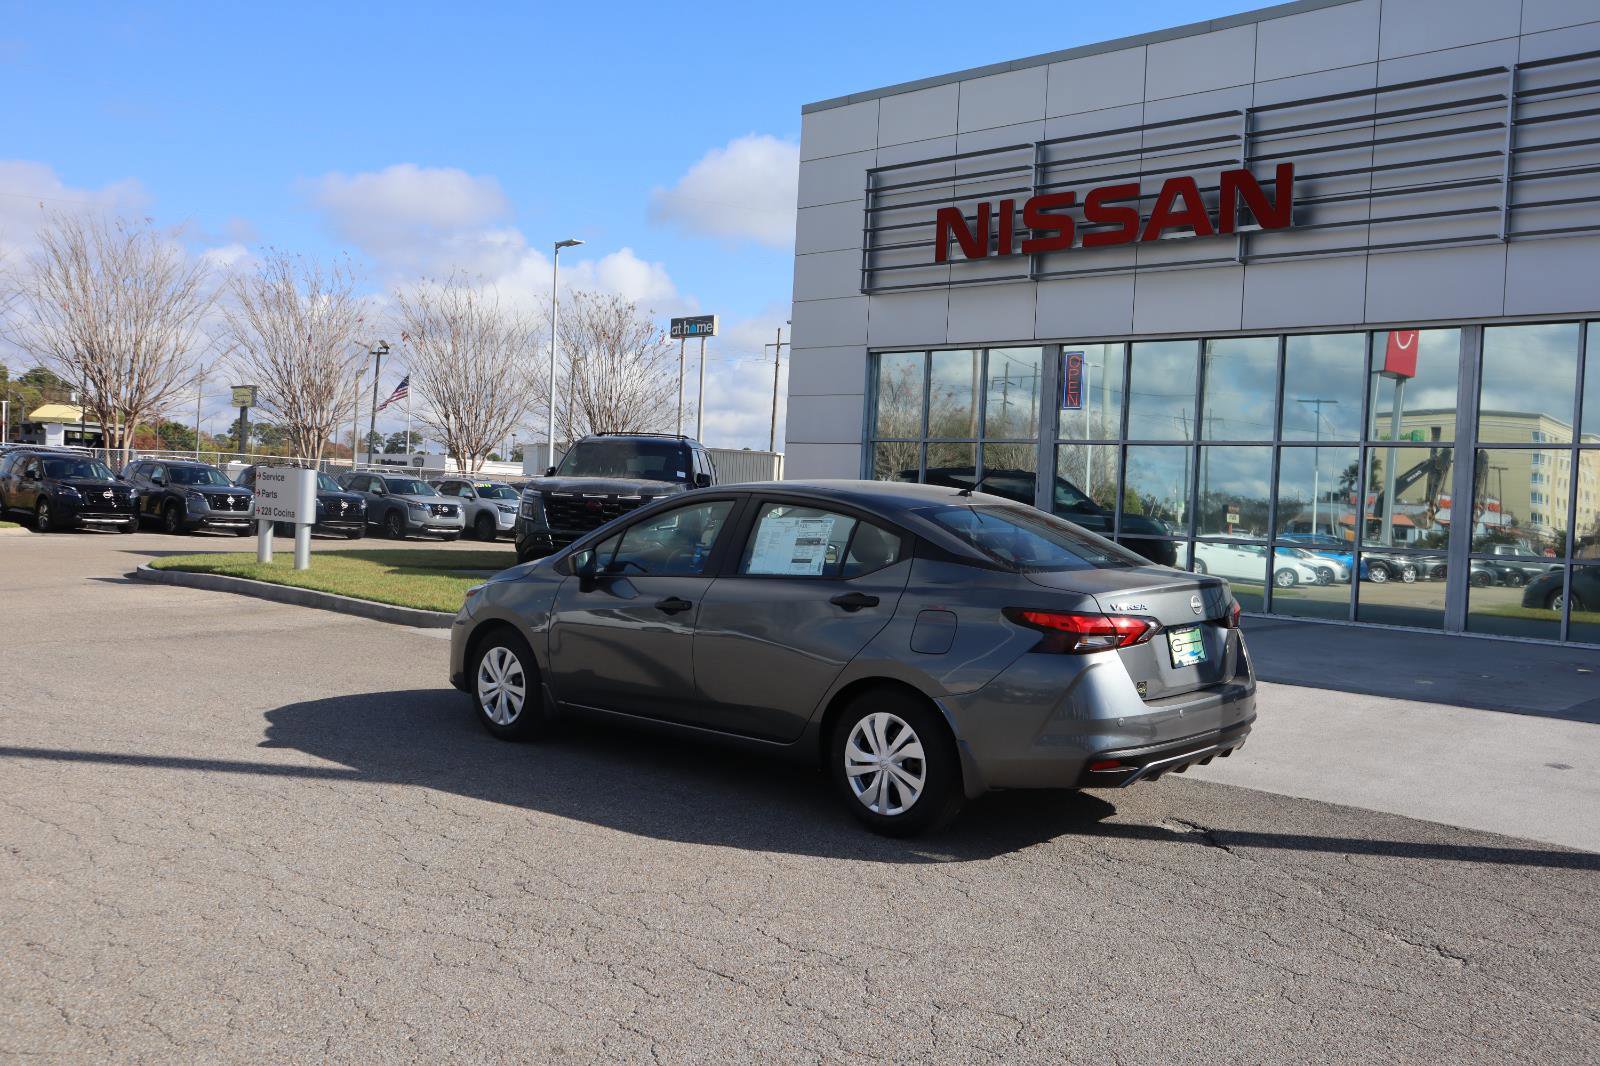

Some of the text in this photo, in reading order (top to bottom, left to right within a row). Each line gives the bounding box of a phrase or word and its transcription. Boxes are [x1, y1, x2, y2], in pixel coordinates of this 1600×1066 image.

[935, 162, 1294, 262] NISSAN
[671, 322, 681, 335] at
[1067, 355, 1081, 406] OPEN
[262, 472, 285, 481] Service
[261, 489, 278, 498] Parts
